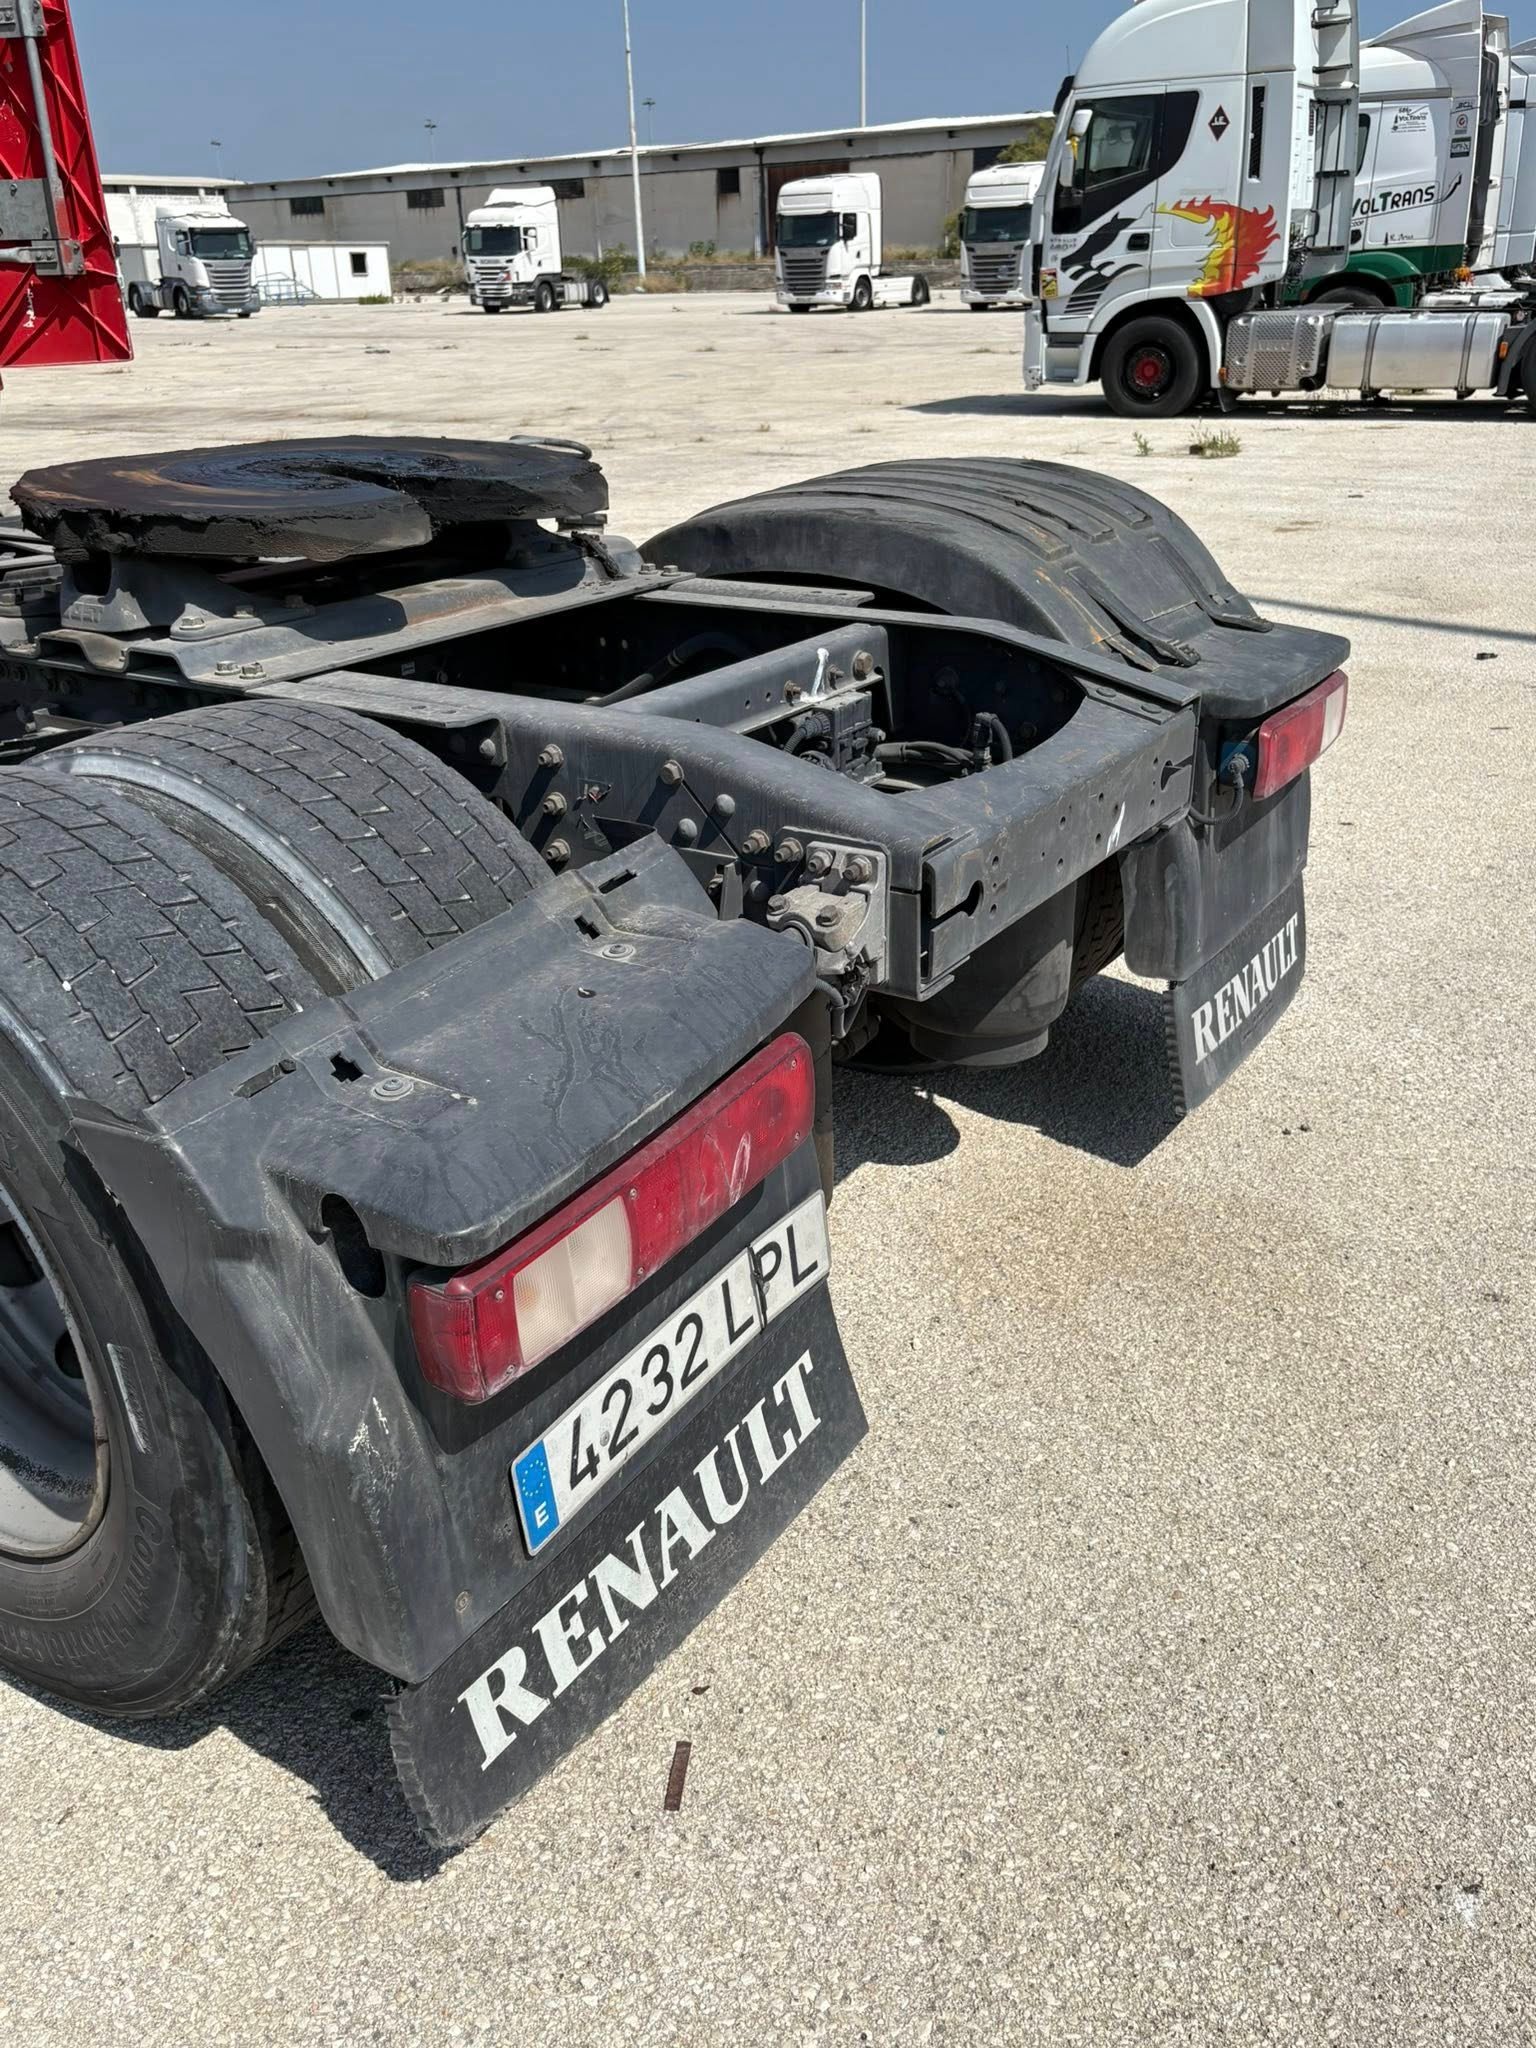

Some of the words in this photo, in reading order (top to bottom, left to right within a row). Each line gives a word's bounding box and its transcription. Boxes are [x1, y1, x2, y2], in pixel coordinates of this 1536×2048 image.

[1191, 911, 1299, 1066] RENAULT
[569, 1312, 709, 1492] 4232
[721, 1223, 819, 1346] LPL
[456, 1349, 821, 1772] RENAULT
[534, 1504, 550, 1529] E
